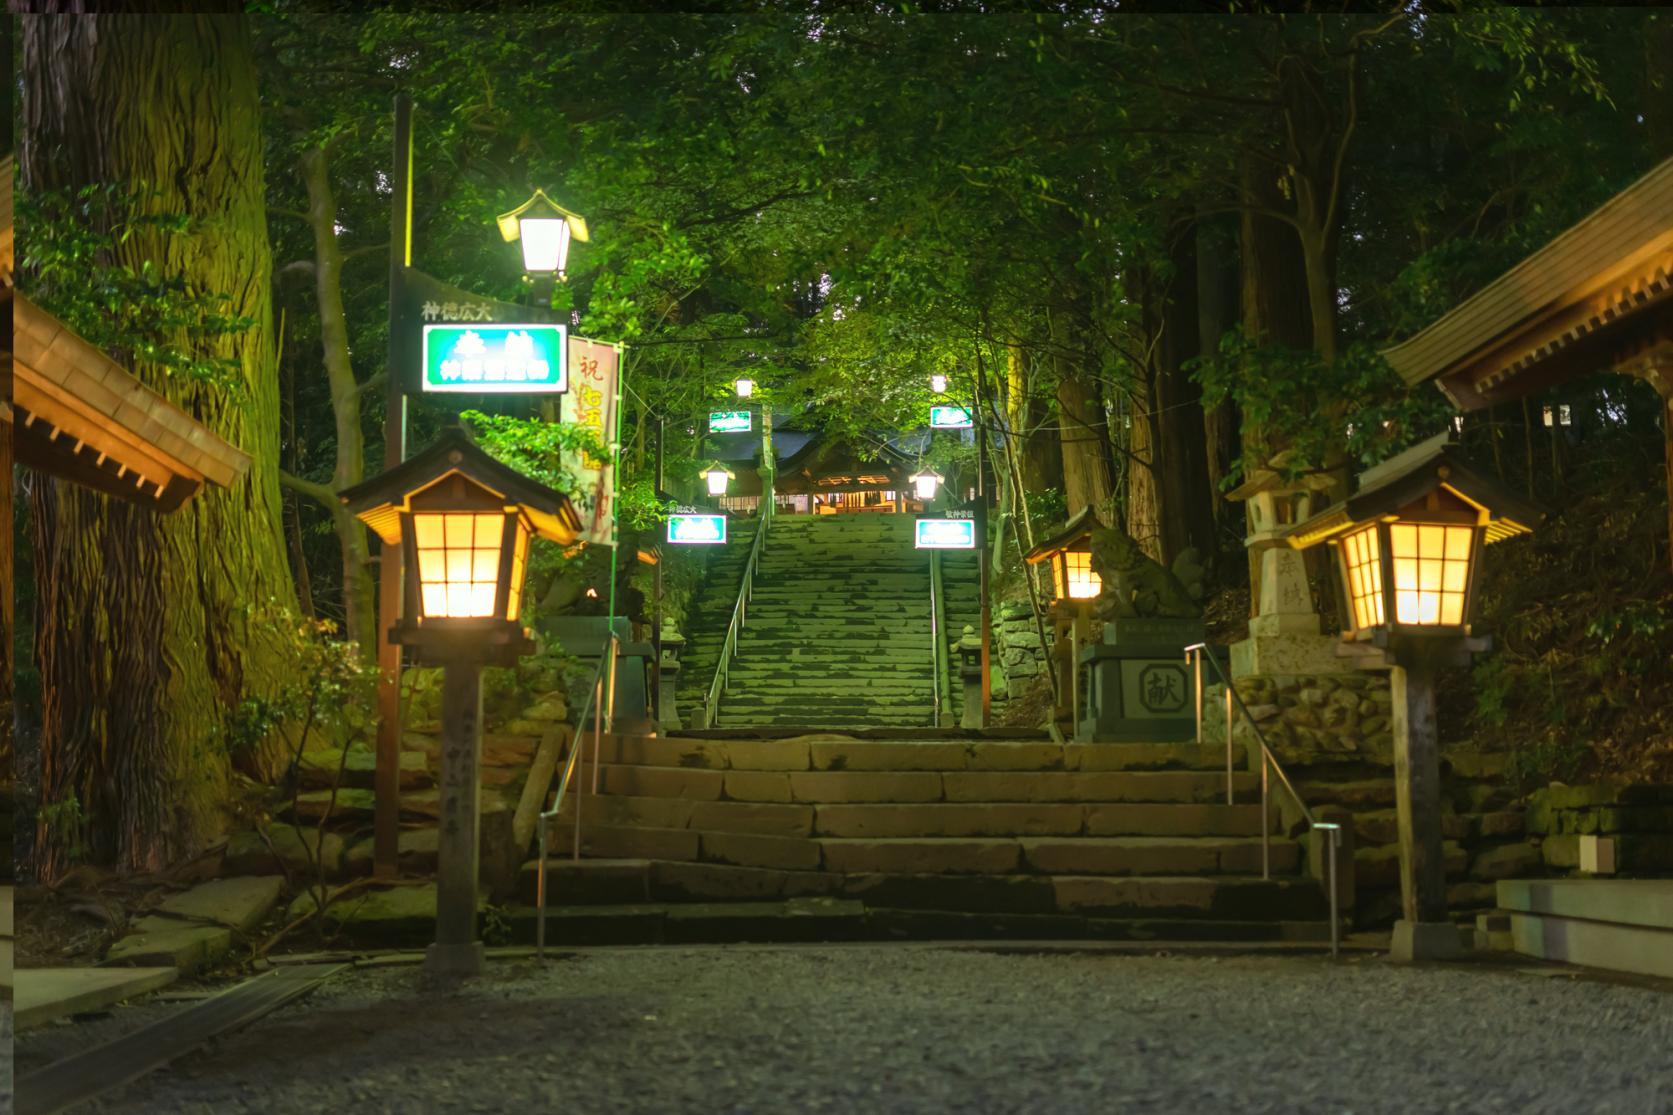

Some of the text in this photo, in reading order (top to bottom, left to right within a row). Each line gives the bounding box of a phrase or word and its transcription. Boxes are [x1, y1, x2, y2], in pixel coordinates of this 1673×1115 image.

[421, 300, 493, 321] 神徳広大
[580, 355, 604, 381] 祝
[1147, 672, 1182, 705] 献
